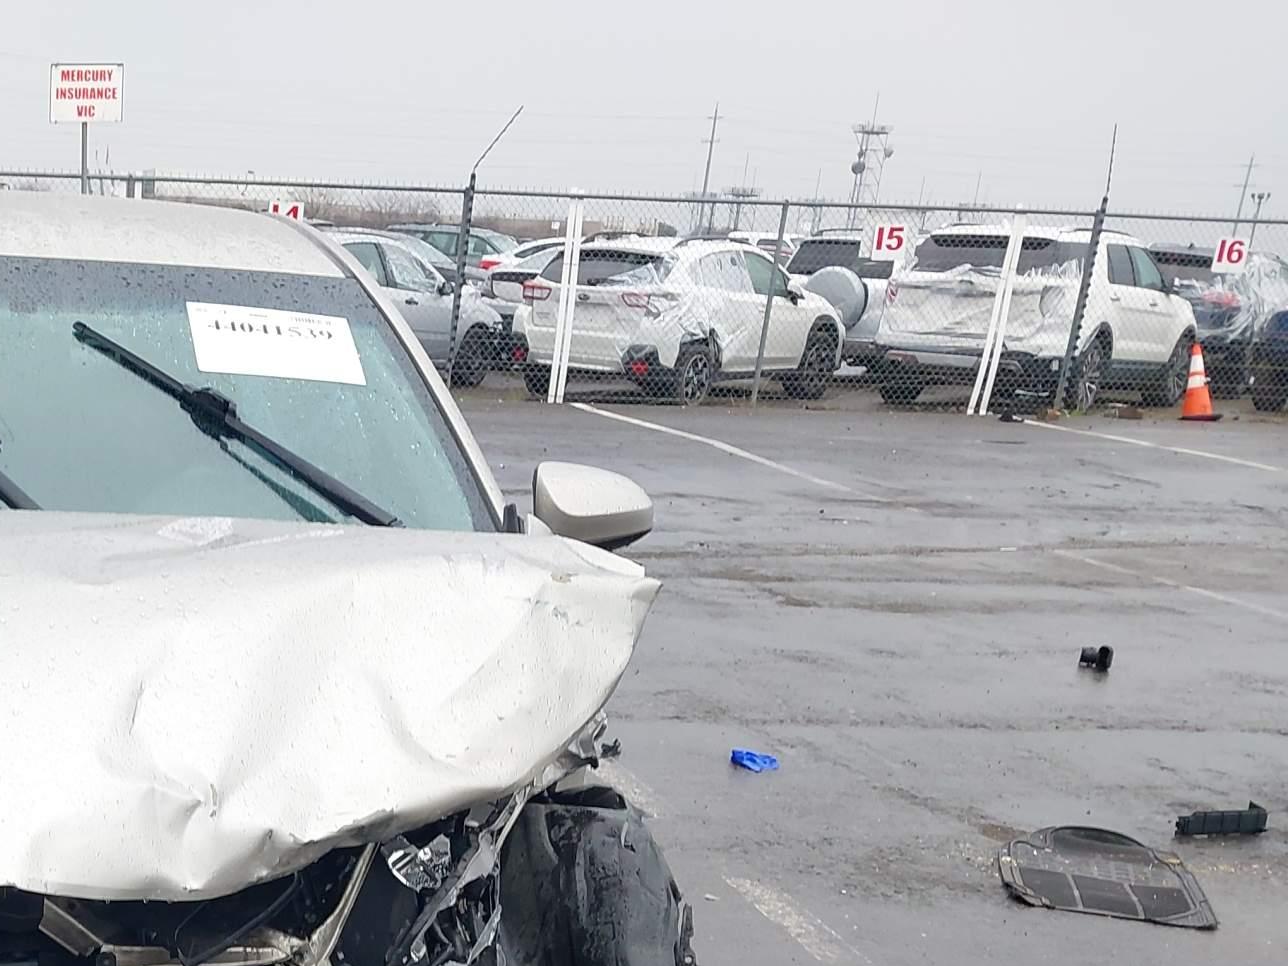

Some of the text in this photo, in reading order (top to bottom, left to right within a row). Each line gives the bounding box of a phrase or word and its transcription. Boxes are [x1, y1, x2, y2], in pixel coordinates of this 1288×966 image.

[60, 69, 113, 82] MERCURY
[55, 87, 118, 100] INSURANCE
[76, 105, 95, 117] VIC
[875, 226, 904, 251] 15
[1216, 239, 1245, 264] 16
